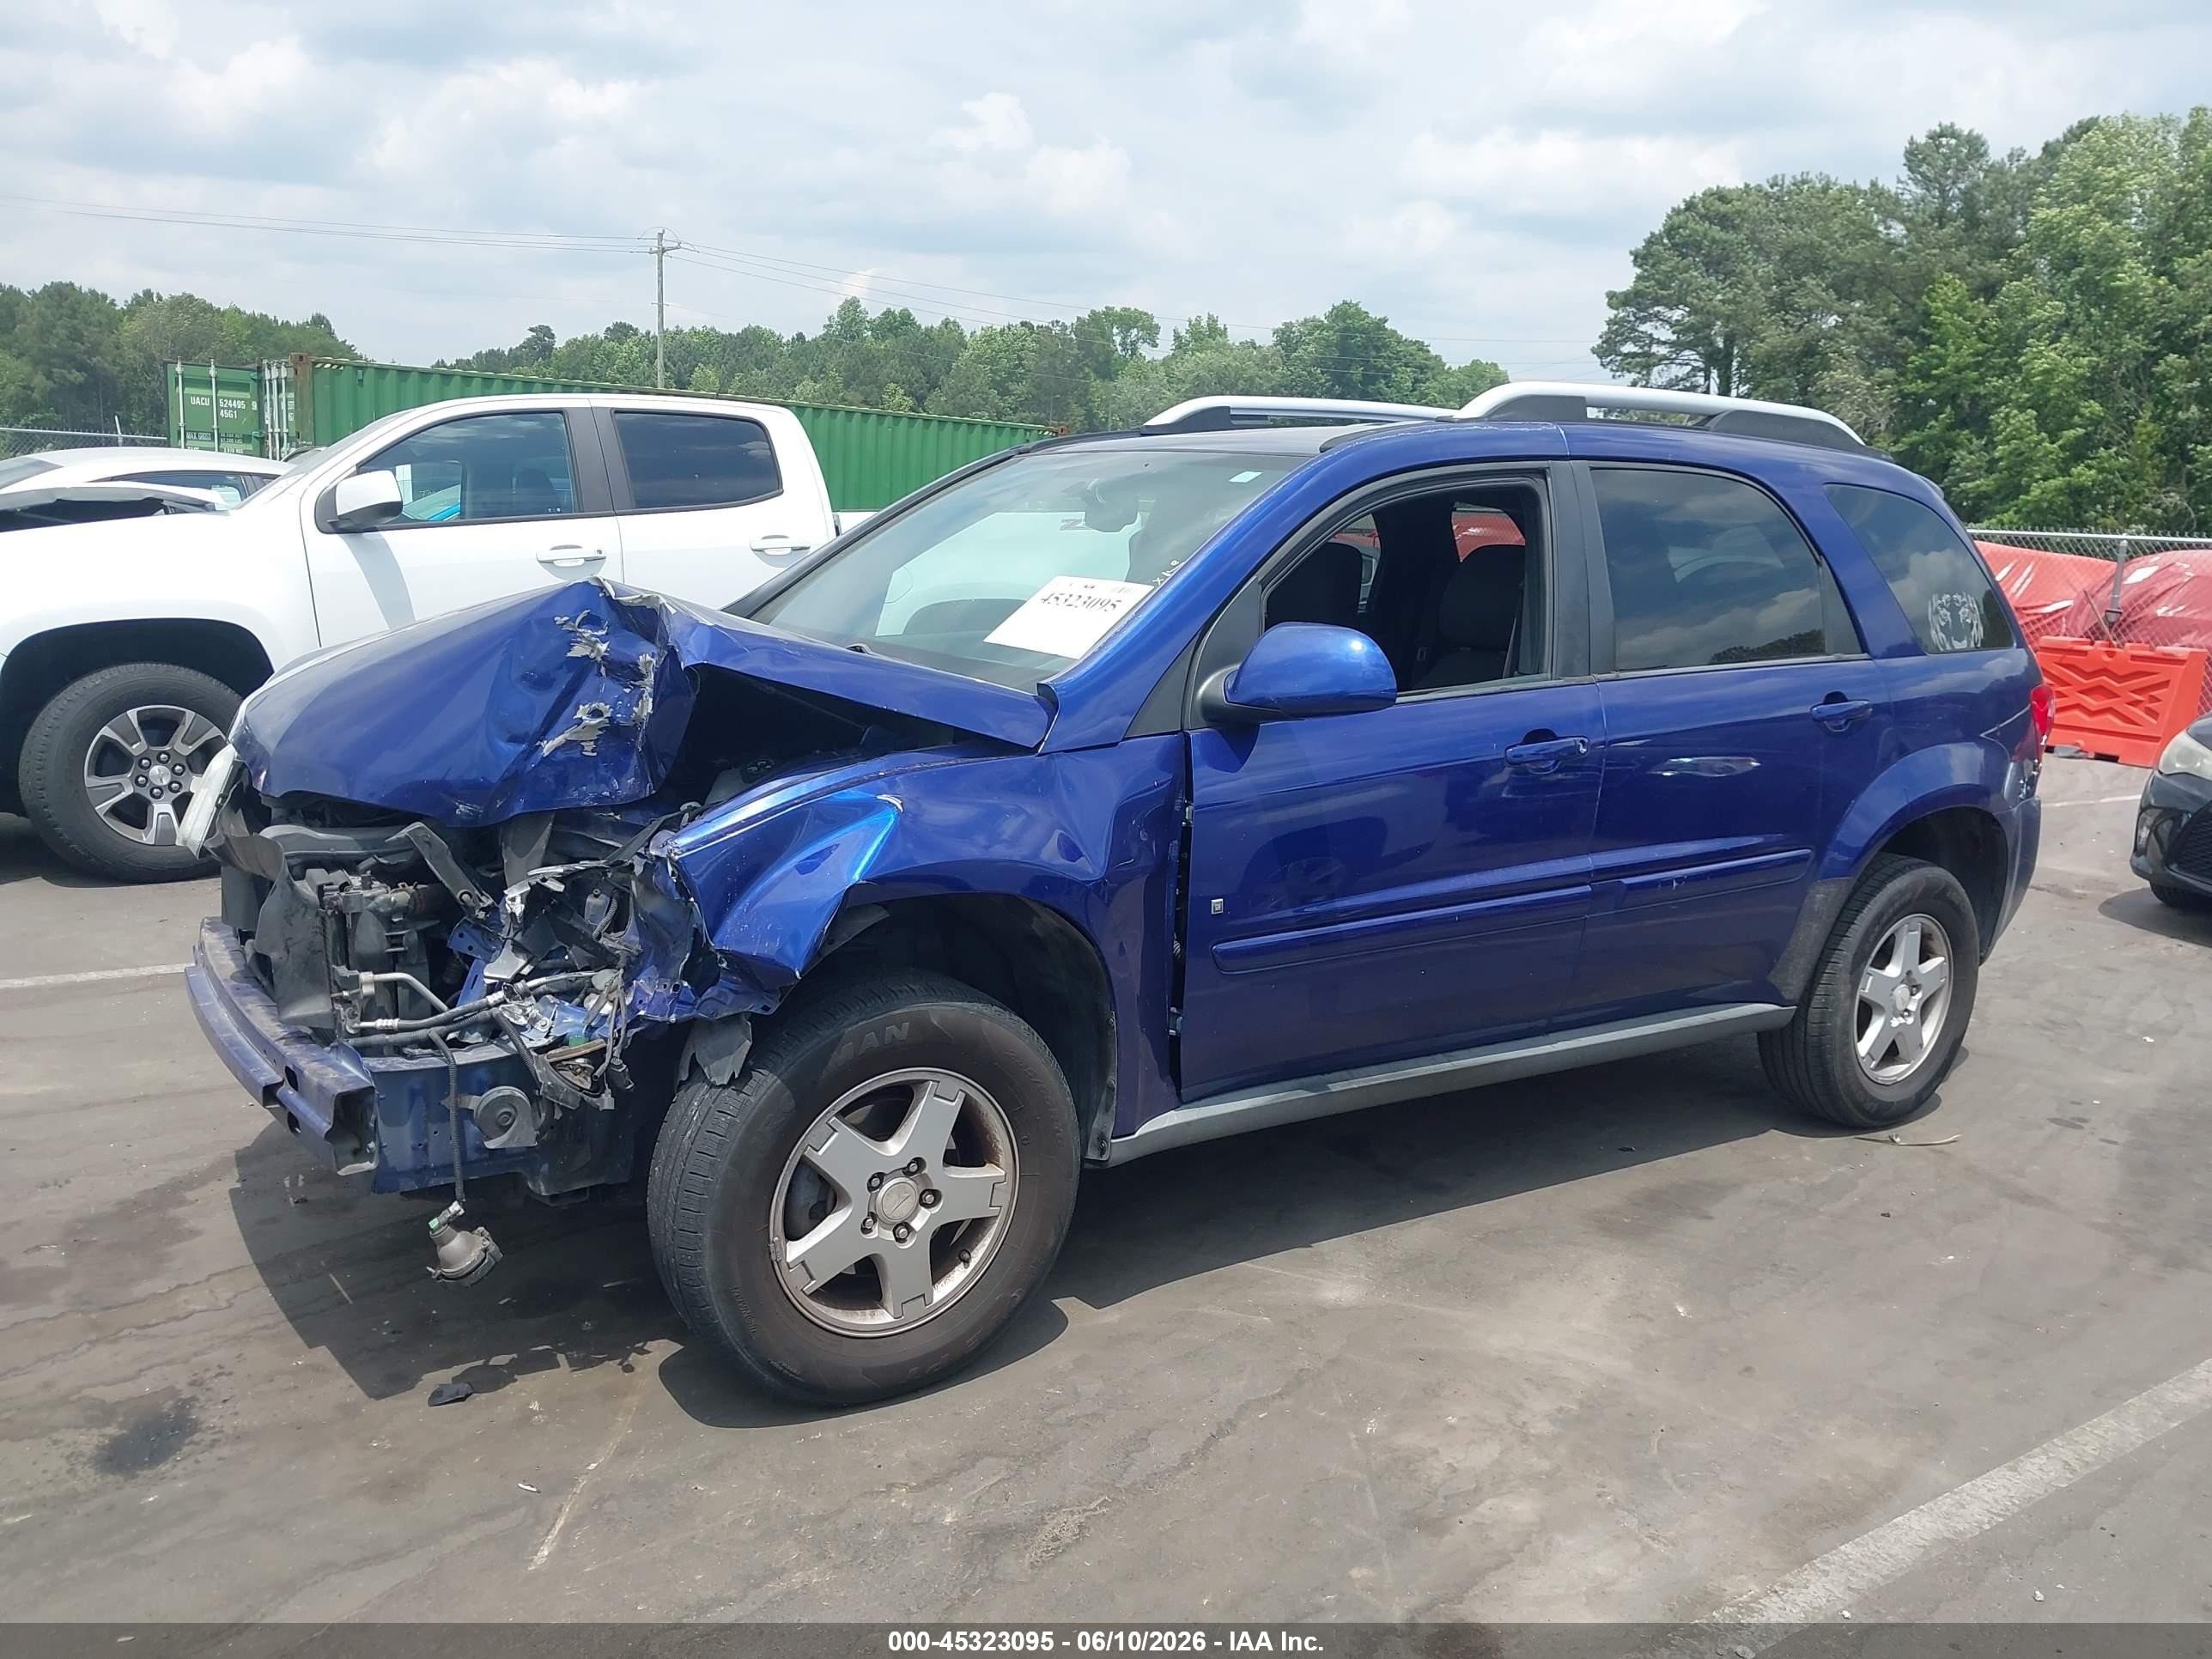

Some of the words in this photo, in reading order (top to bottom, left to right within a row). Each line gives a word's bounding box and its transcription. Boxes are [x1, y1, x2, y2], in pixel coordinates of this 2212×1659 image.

[191, 396, 210, 406] UACU
[220, 410, 238, 419] 45G1
[1041, 592, 1122, 612] 45323095
